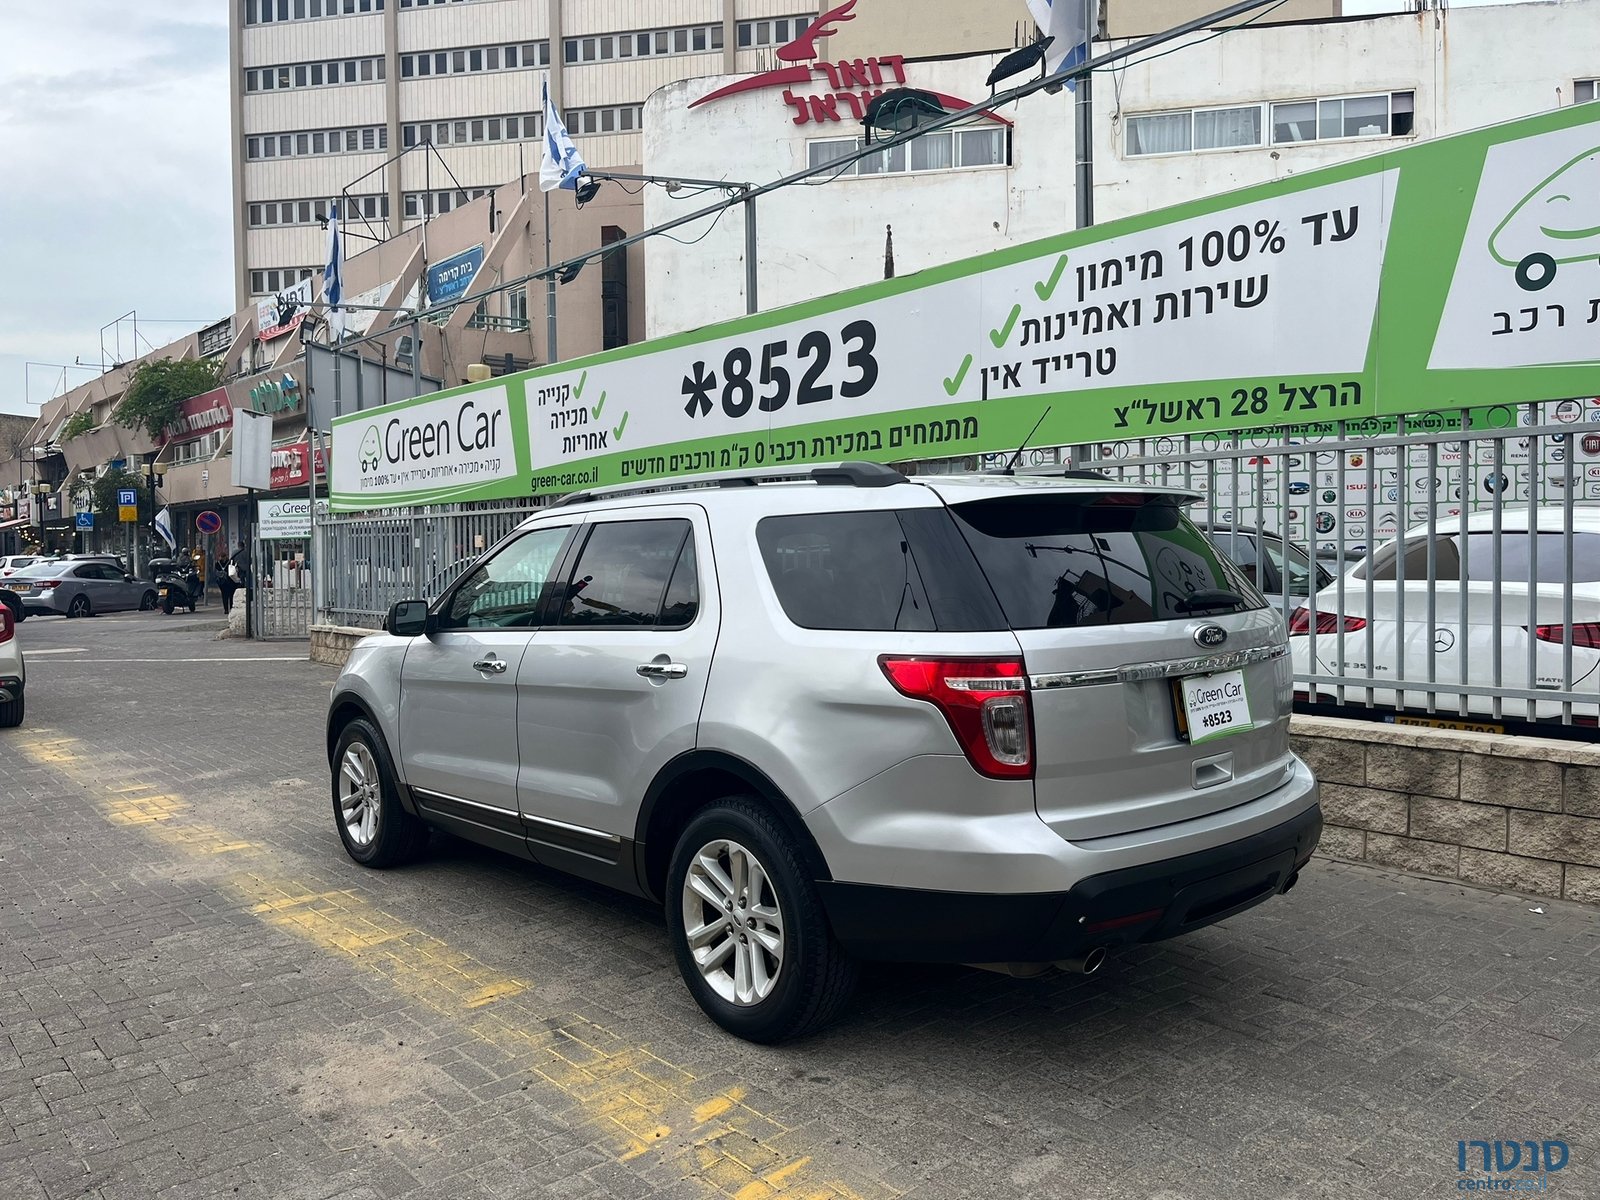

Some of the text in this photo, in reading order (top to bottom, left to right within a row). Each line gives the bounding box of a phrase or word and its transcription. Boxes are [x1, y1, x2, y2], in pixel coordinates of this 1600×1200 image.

[813, 55, 906, 89] דואר
[783, 88, 885, 125] ראל
[1075, 205, 1359, 302] עד 100% מימון
[438, 262, 473, 283] בית קדימה
[1020, 273, 1269, 347] שירות ואמינות
[1491, 304, 1565, 335] רכב
[980, 346, 1117, 400] טרייד אין
[538, 384, 570, 406] קנייה
[1114, 380, 1362, 430] הרצל 28 ראשל"צ
[551, 406, 588, 430] מכירה
[1269, 424, 1309, 435] המתג
[1346, 420, 1377, 431] לבחו
[385, 401, 501, 464] Green Car
[563, 430, 608, 453] אחריות
[621, 416, 978, 477] מתמחים במכירת רכבי 0 ק"מ ורכבים חדשים
[1585, 439, 1600, 450] FIAT
[431, 464, 454, 478] אחריות
[458, 461, 479, 475] מכירה
[484, 458, 500, 474] קניה
[374, 475, 390, 486] 100%
[531, 466, 599, 491] green-car.co.il
[1205, 628, 1223, 643] Ford
[1196, 682, 1242, 704] Green Car
